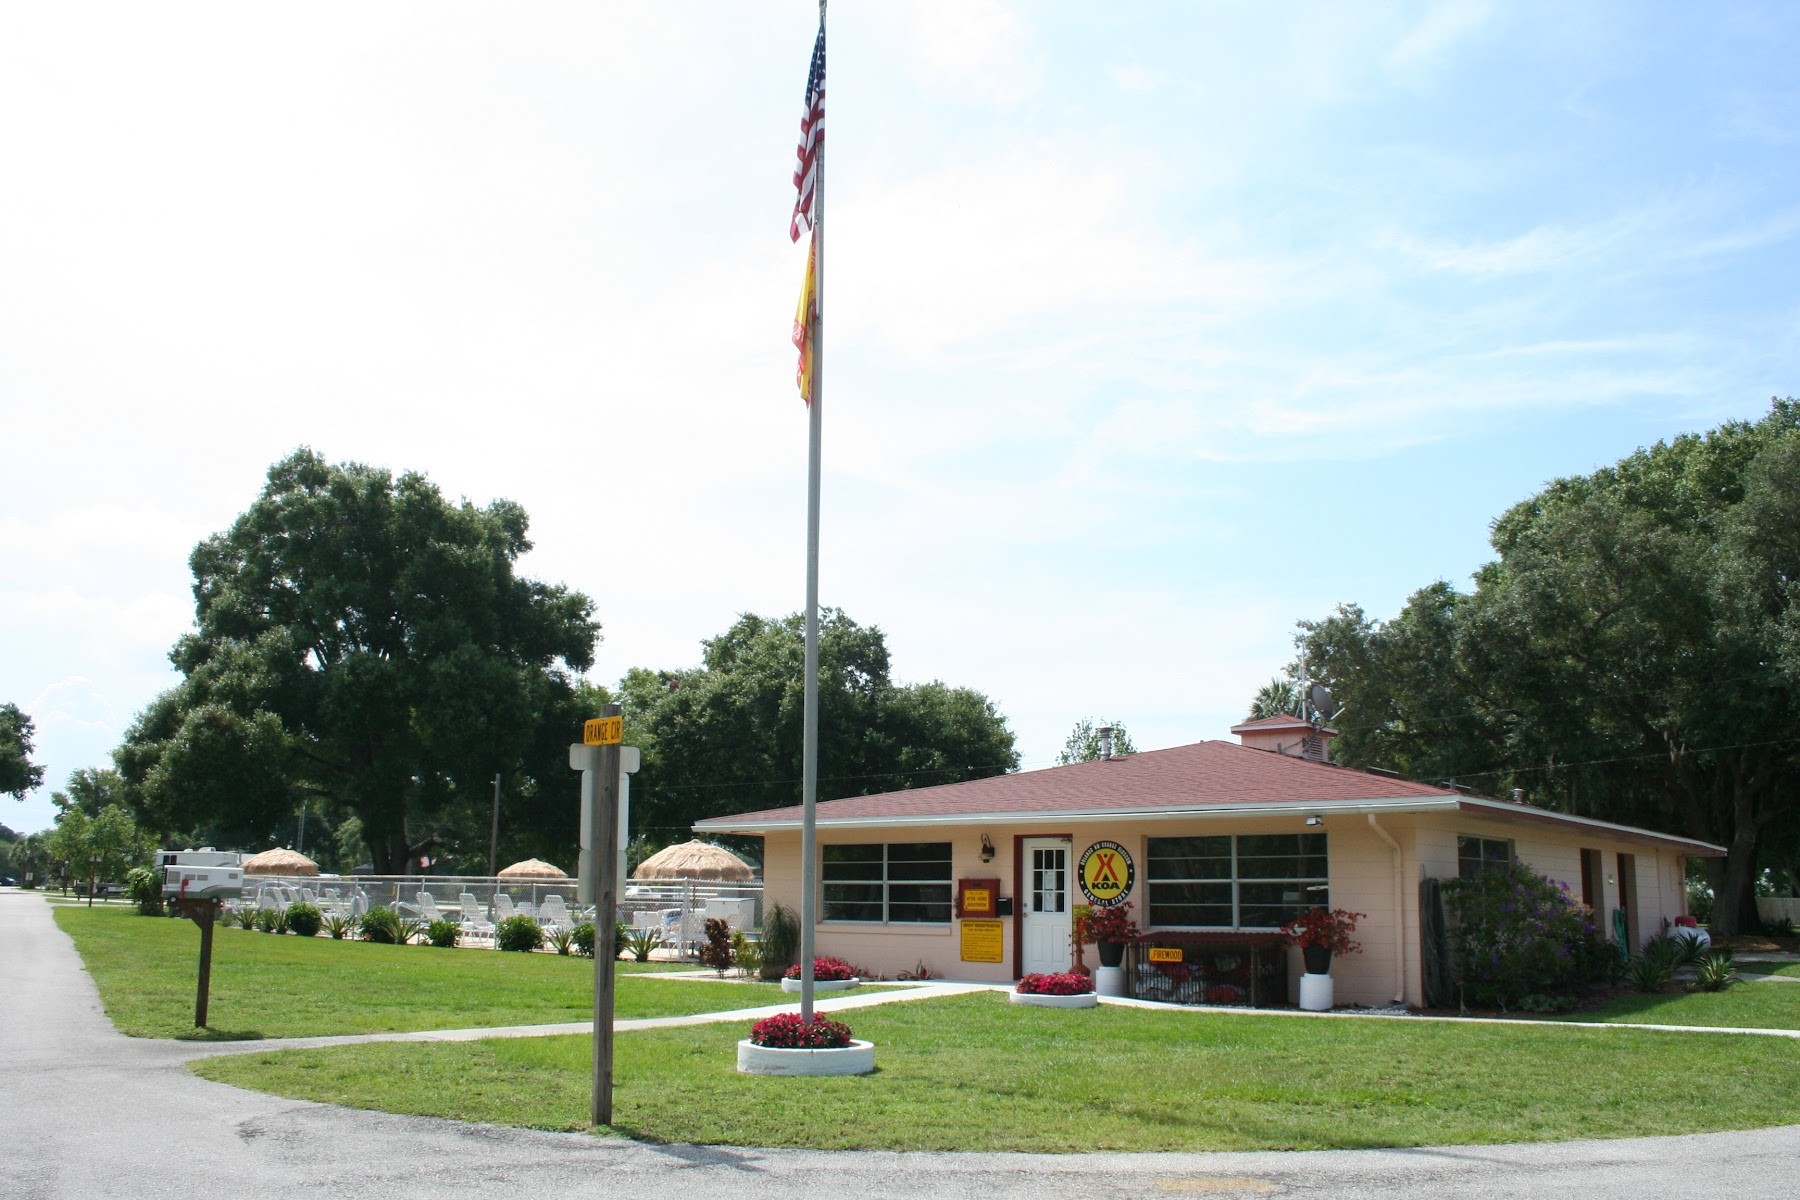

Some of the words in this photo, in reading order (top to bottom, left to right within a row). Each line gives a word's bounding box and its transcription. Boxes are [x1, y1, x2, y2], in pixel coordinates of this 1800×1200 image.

[586, 722, 608, 742] ORANGE
[611, 720, 621, 740] CIR
[1117, 846, 1131, 865] BLOSSOM
[1111, 889, 1129, 905] STORE
[1153, 950, 1181, 960] FIREWOOD
